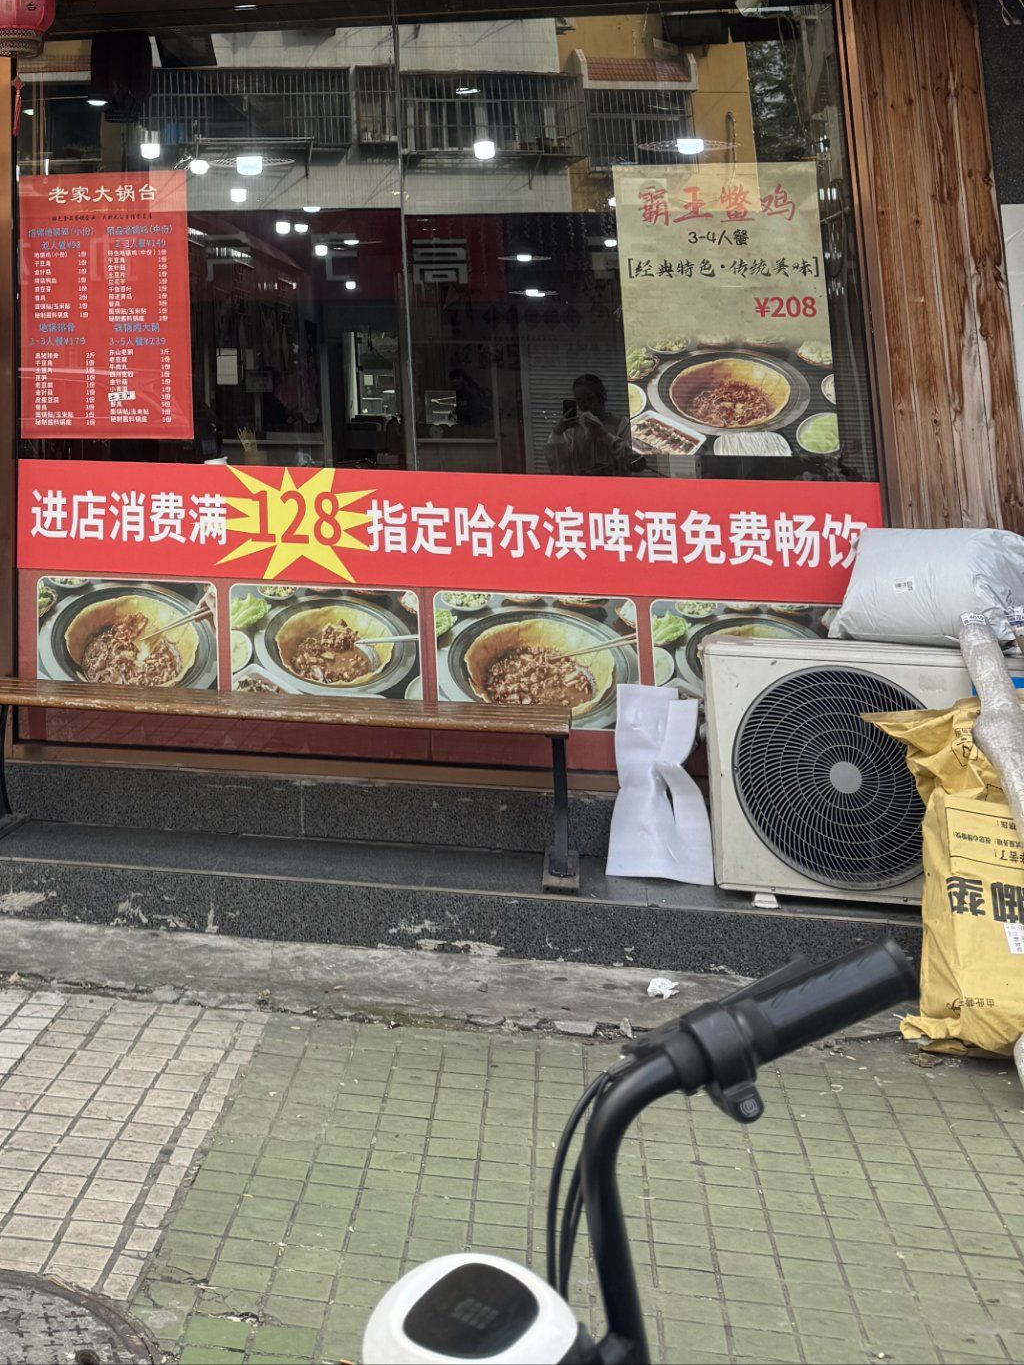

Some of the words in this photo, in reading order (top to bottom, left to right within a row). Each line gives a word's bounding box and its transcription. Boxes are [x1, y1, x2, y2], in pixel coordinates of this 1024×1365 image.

[48, 183, 157, 204] 老家大锅台
[637, 183, 796, 226] 霸王鳖鸡
[754, 295, 818, 318] ¥208
[30, 489, 227, 545] 进店消费满
[252, 489, 342, 546] 128
[366, 498, 869, 568] 指定哈尔滨啤酒免费畅饮
